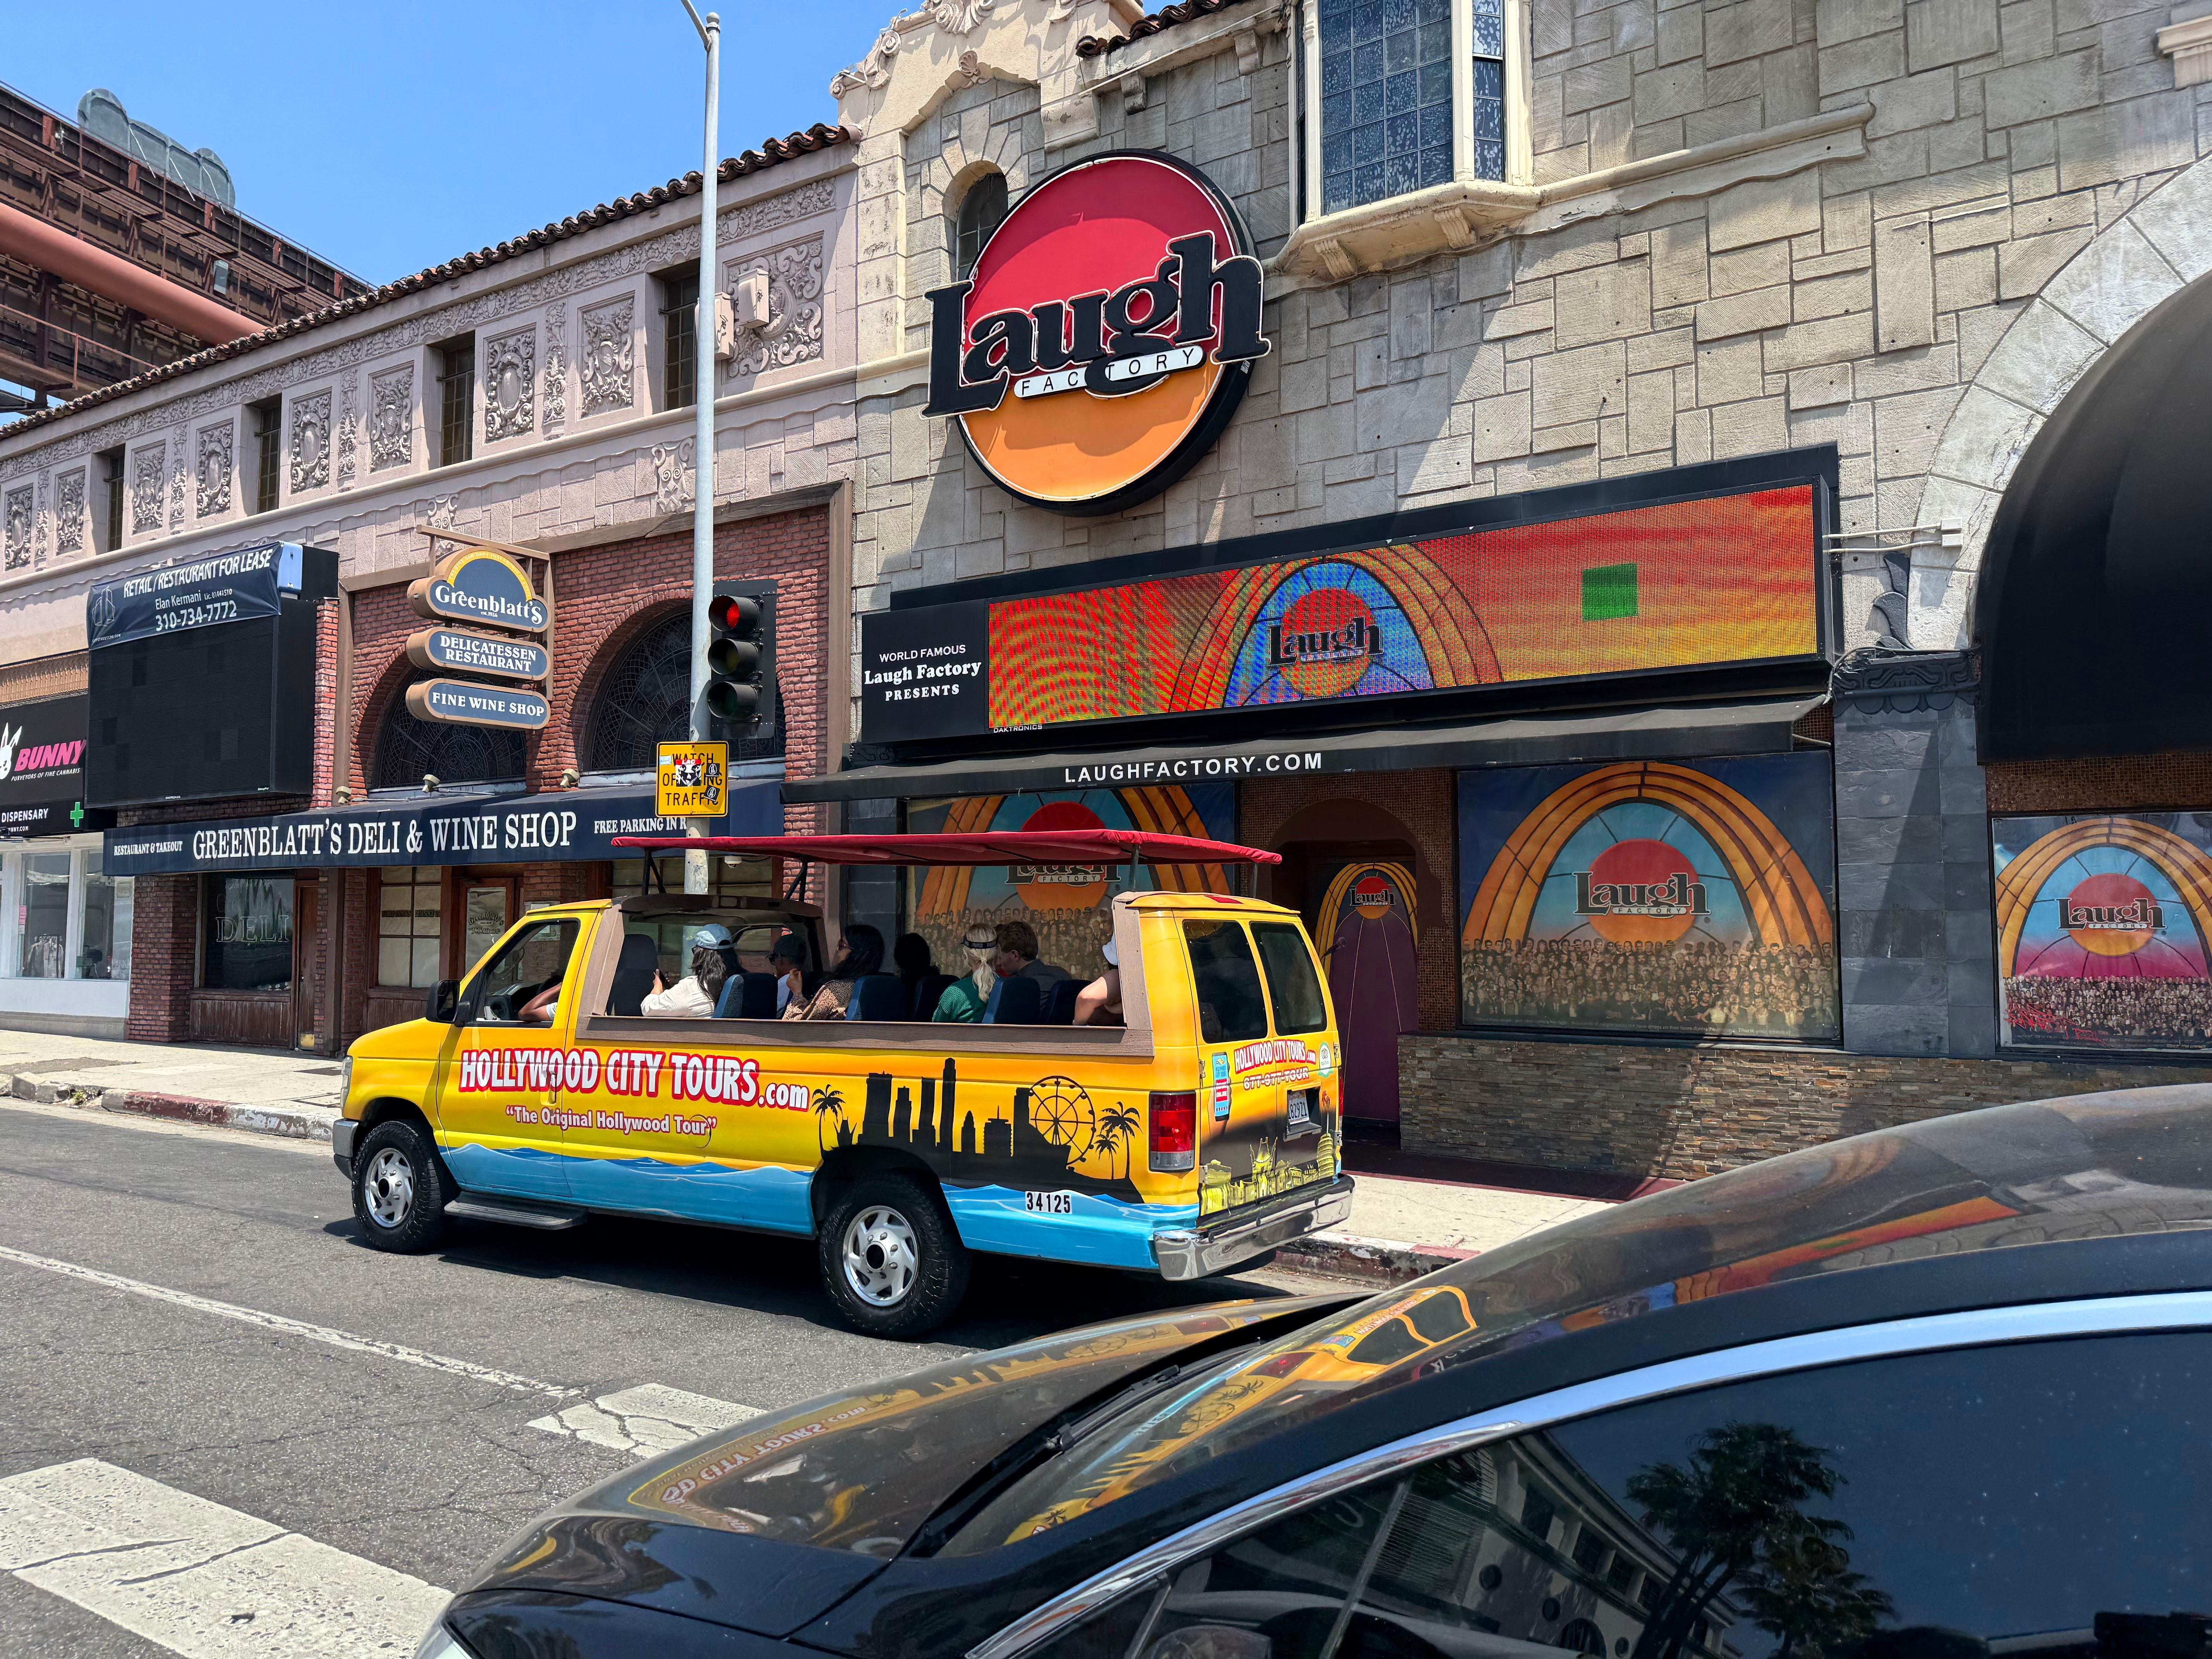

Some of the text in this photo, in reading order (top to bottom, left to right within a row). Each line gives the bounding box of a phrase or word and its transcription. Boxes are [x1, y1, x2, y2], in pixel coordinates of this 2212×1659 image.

[919, 230, 1272, 419] Laugh
[1022, 347, 1194, 394] FACTORY
[124, 577, 151, 598] RETAIL
[158, 562, 216, 589] RESTAURANT
[220, 556, 239, 575] FOR
[240, 549, 273, 572] LEASE
[156, 598, 170, 610] Elan
[171, 590, 201, 606] Kermani
[435, 585, 543, 624] Greenblatt's
[155, 600, 237, 632] 310-734-7772
[440, 635, 536, 661] DELICATESSEN
[879, 644, 966, 663] WORLD FAMOUS
[1269, 617, 1384, 666] Laugh
[446, 649, 531, 672] RESTAURANT
[864, 661, 982, 685] Laugh Factory
[433, 692, 544, 717] FINE WINE SHOP
[885, 684, 959, 701] PRESENTS
[993, 724, 1042, 733] DAKTRONICS
[14, 740, 86, 771] BUNNY
[1065, 752, 1321, 783] LAUGHFACTORY.COM
[11, 773, 36, 781] PURVEYORS
[57, 768, 81, 776] CANNABIS
[2, 808, 49, 823] DISPENSARY
[114, 844, 149, 856] RESTAURANT
[150, 843, 155, 853] &
[156, 841, 183, 854] TAKEOUT
[194, 818, 342, 860] GREENBLATT'S
[348, 821, 400, 854] DELI
[406, 819, 422, 854] &
[429, 815, 497, 852] WINE
[505, 811, 576, 849] SHOP
[594, 819, 618, 834] FREE
[620, 817, 664, 833] PARKING
[666, 817, 678, 831] IN
[1350, 889, 1396, 907] Laugh
[1573, 871, 1711, 919] Laugh
[216, 915, 289, 942] DELI
[2054, 898, 2167, 931] Laugh
[1234, 1041, 1273, 1074] HOLLYWOOD
[1273, 1040, 1286, 1063] CITY
[459, 1048, 600, 1093] HOLLYWOOD
[606, 1050, 665, 1098] CITY
[506, 1104, 717, 1136] "The Original Hollywood Tour"
[1027, 1192, 1070, 1213] 34125
